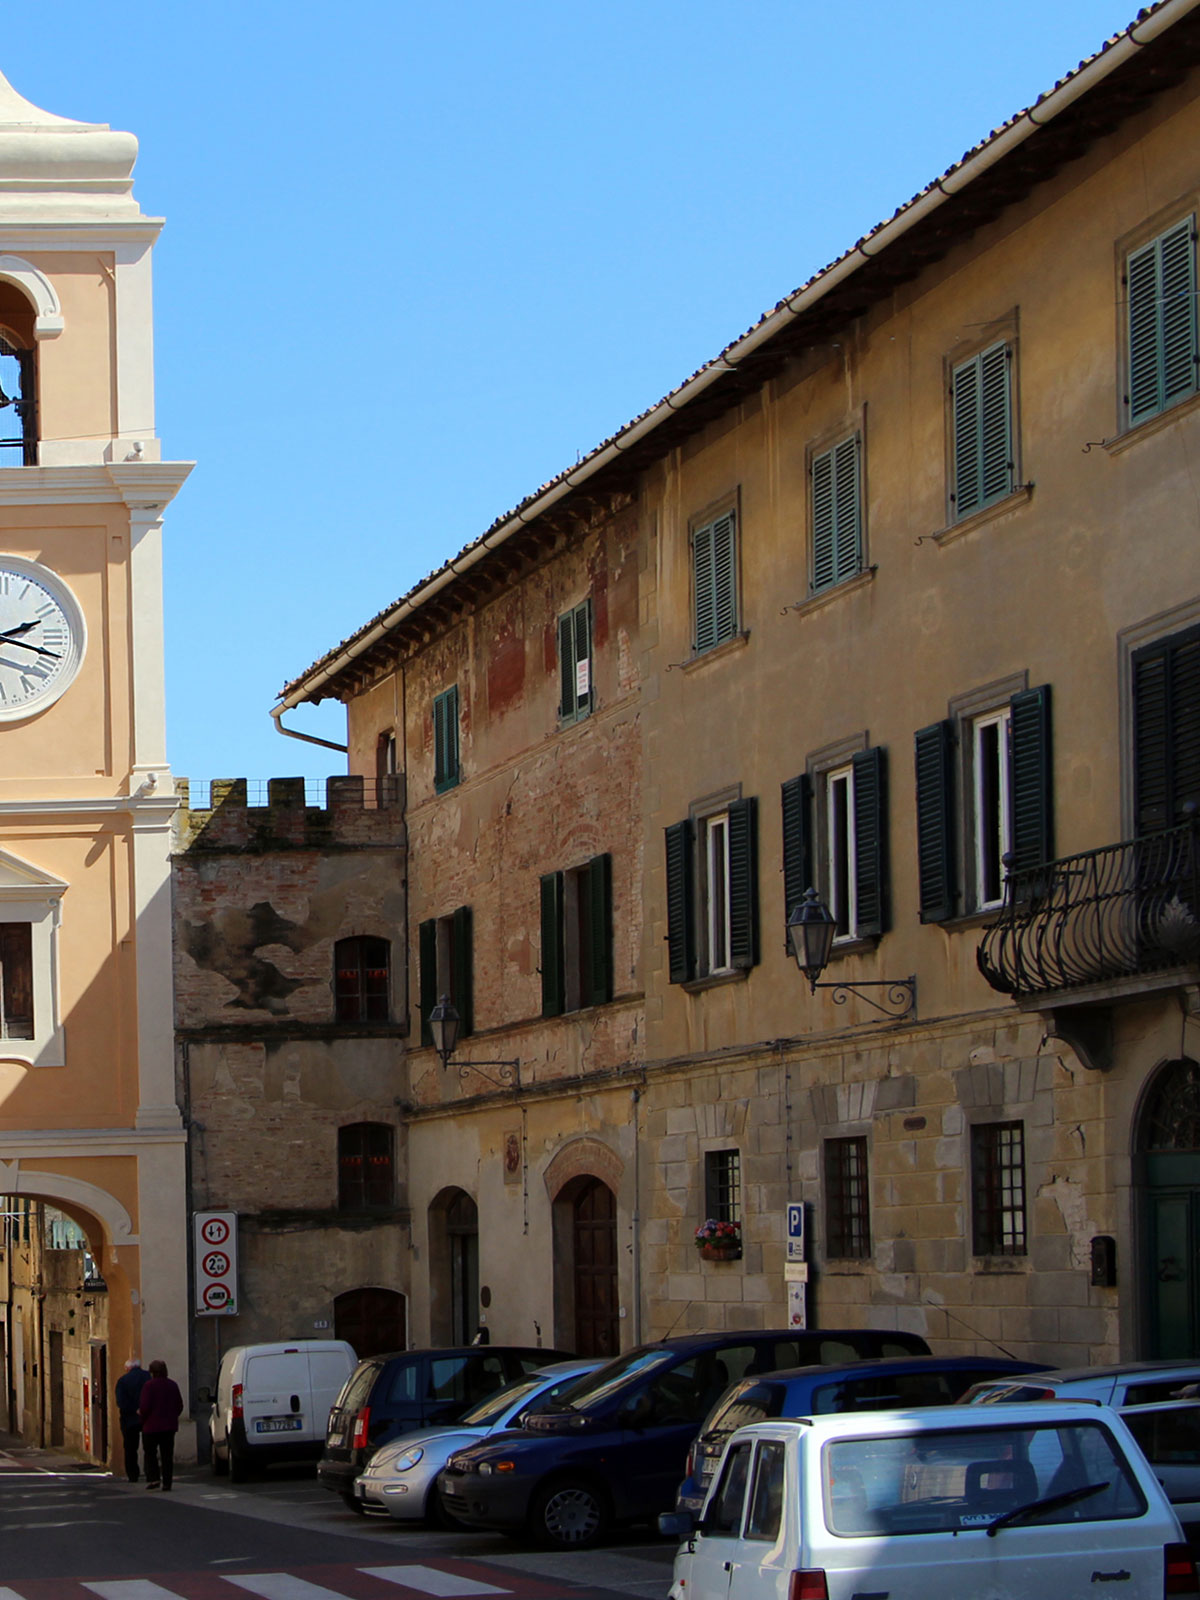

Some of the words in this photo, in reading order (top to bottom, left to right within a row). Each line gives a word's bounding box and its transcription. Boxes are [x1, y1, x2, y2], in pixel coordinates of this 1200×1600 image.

[19, 583, 31, 600] I
[34, 602, 57, 619] II
[42, 628, 64, 646] III
[790, 1210, 800, 1233] P
[208, 1257, 216, 1271] 2
